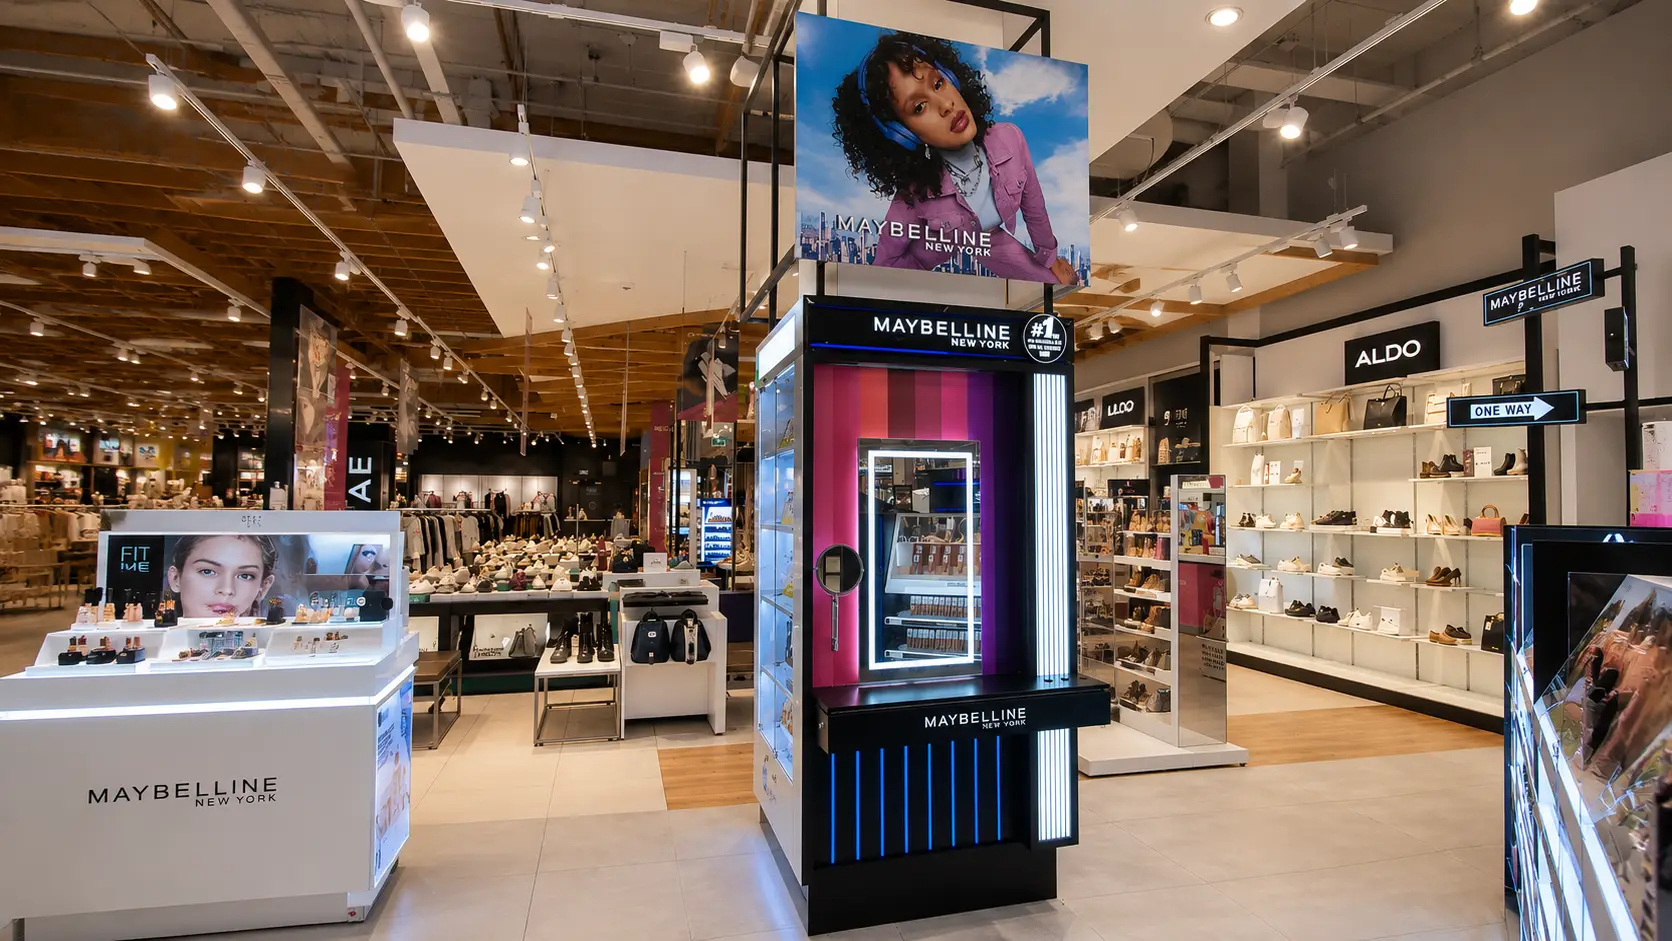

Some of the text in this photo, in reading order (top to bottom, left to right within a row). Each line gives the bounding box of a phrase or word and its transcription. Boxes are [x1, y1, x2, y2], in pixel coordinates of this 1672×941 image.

[836, 214, 991, 247] MAYBELLINE
[925, 242, 991, 257] NEW YORK
[1490, 272, 1582, 310] MAYBELLINE
[873, 316, 1010, 341] MAYBELLINE
[951, 337, 1010, 350] NEW YORK
[1355, 339, 1421, 368] ALDO
[1475, 403, 1532, 417] ONE WAY
[120, 546, 151, 562] FIT
[925, 708, 1026, 728] MAYBELLINE
[88, 777, 278, 805] MAYBELLINE
[195, 793, 277, 807] NEW YORK
